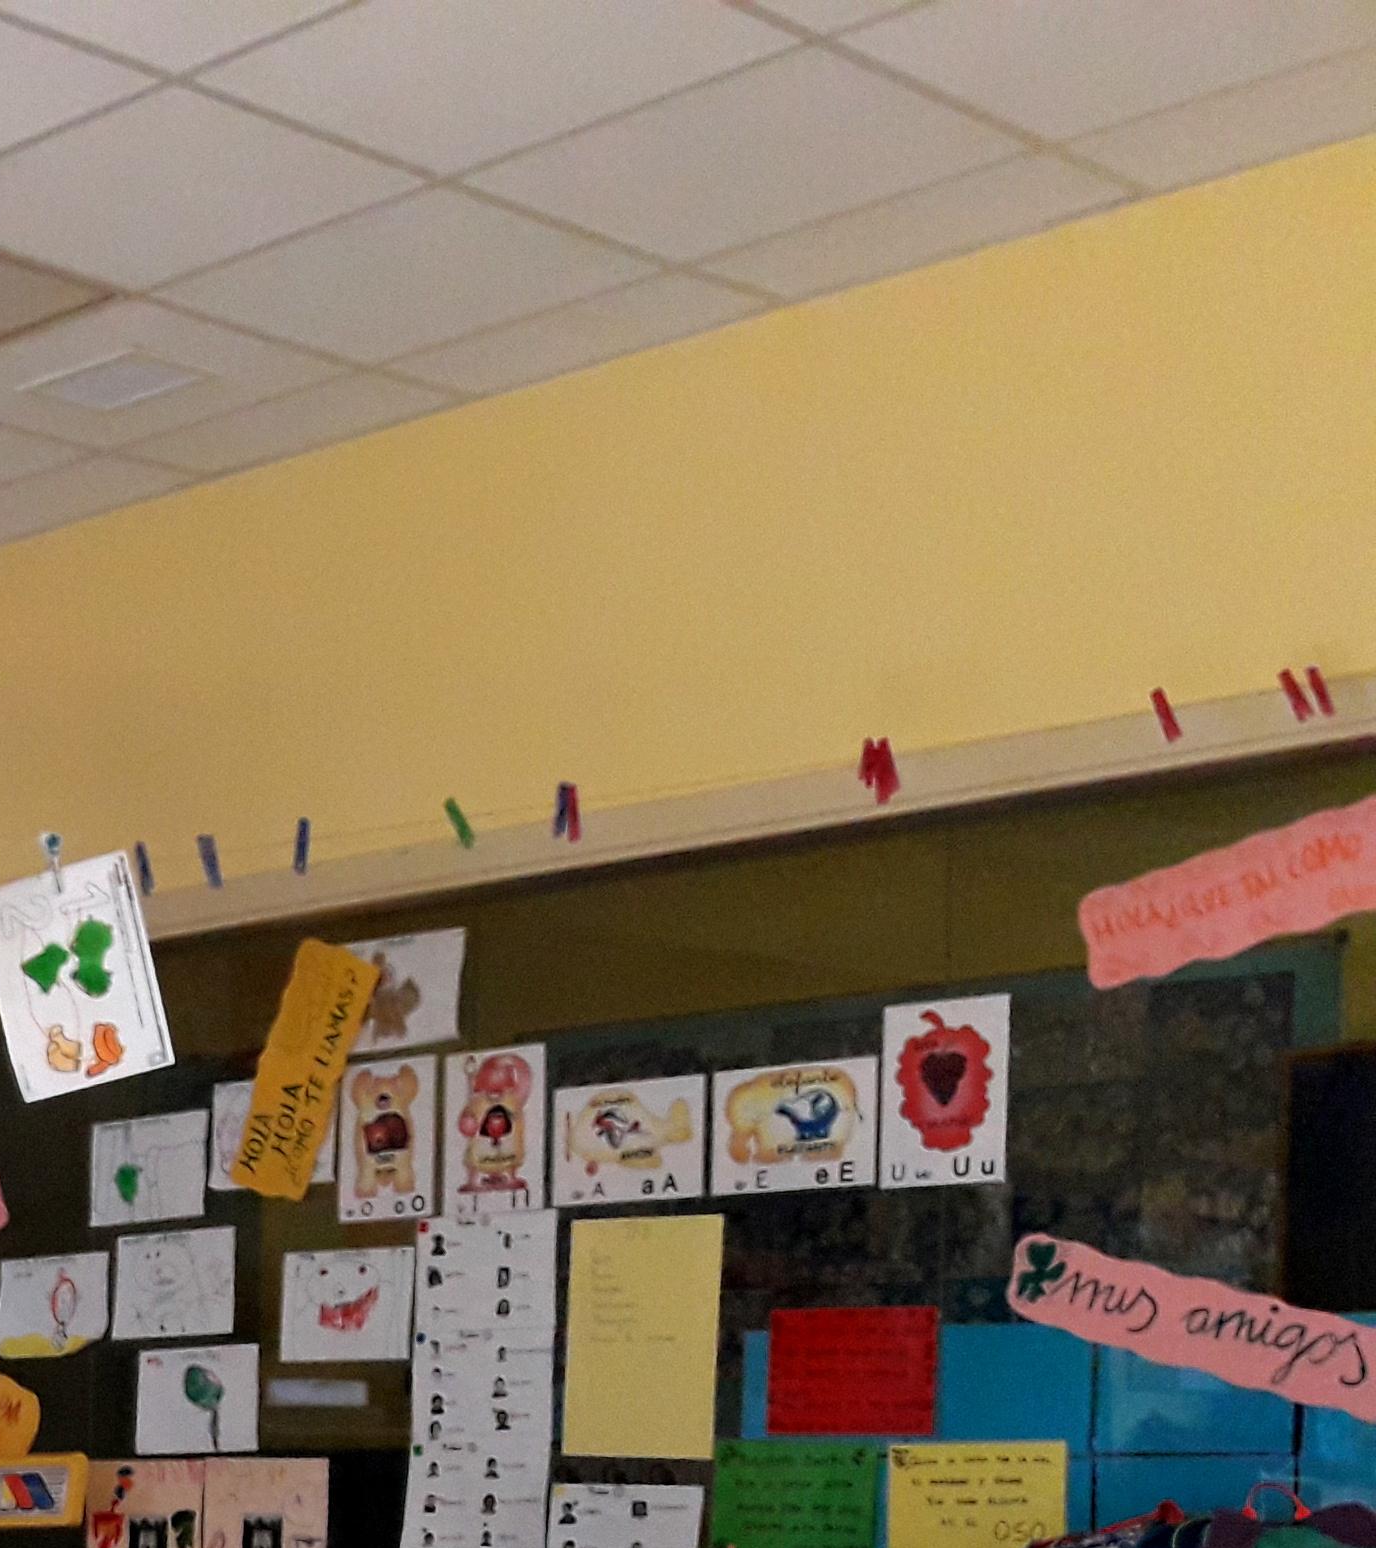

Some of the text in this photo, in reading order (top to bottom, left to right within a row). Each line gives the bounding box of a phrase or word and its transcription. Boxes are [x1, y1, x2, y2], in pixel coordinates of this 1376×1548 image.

[273, 1083, 304, 1159] HOLA
[755, 1161, 855, 1189] E e E
[892, 1162, 906, 1182] U
[952, 1155, 971, 1178] U
[980, 1159, 995, 1176] u
[642, 1178, 655, 1196] a
[662, 1172, 679, 1193] A
